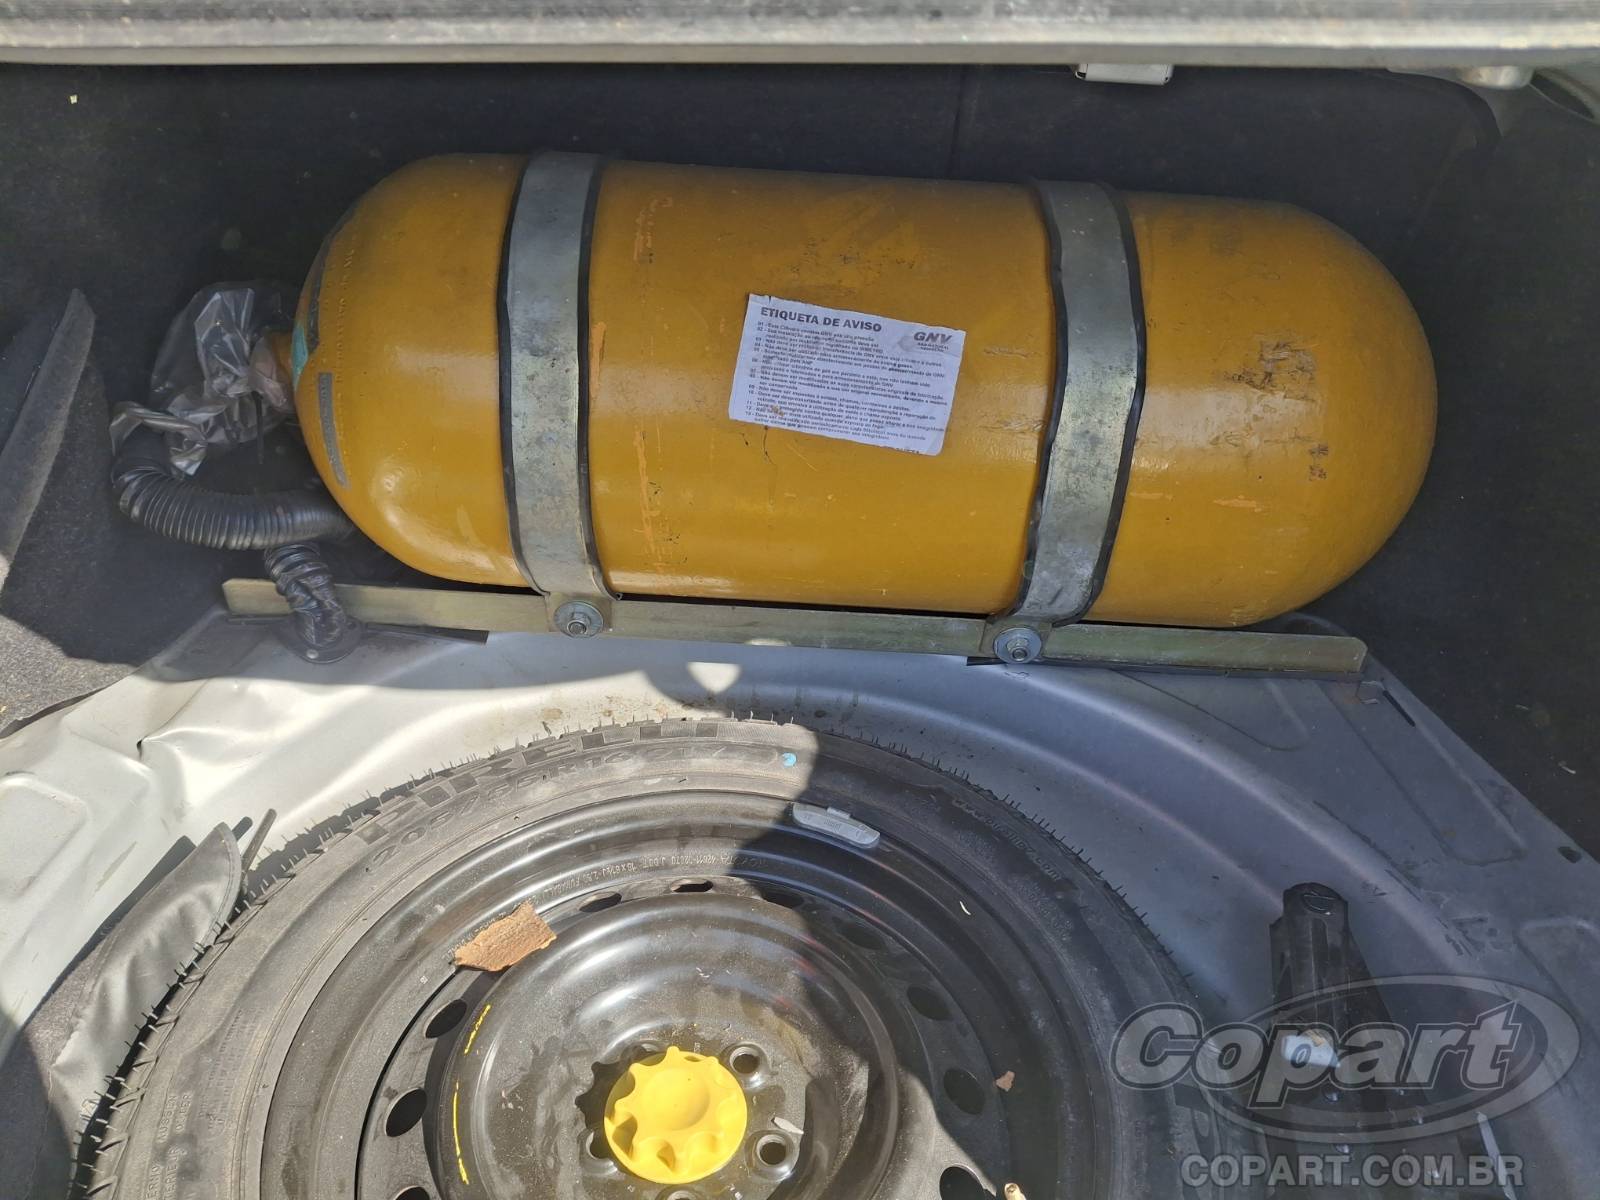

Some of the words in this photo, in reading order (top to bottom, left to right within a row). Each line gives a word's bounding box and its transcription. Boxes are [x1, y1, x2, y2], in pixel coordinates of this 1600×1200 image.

[760, 306, 819, 324] ETIQUETA
[822, 315, 841, 327] DE
[842, 318, 882, 333] AVISO
[913, 331, 951, 343] GNV
[354, 722, 719, 846] PIRELLI
